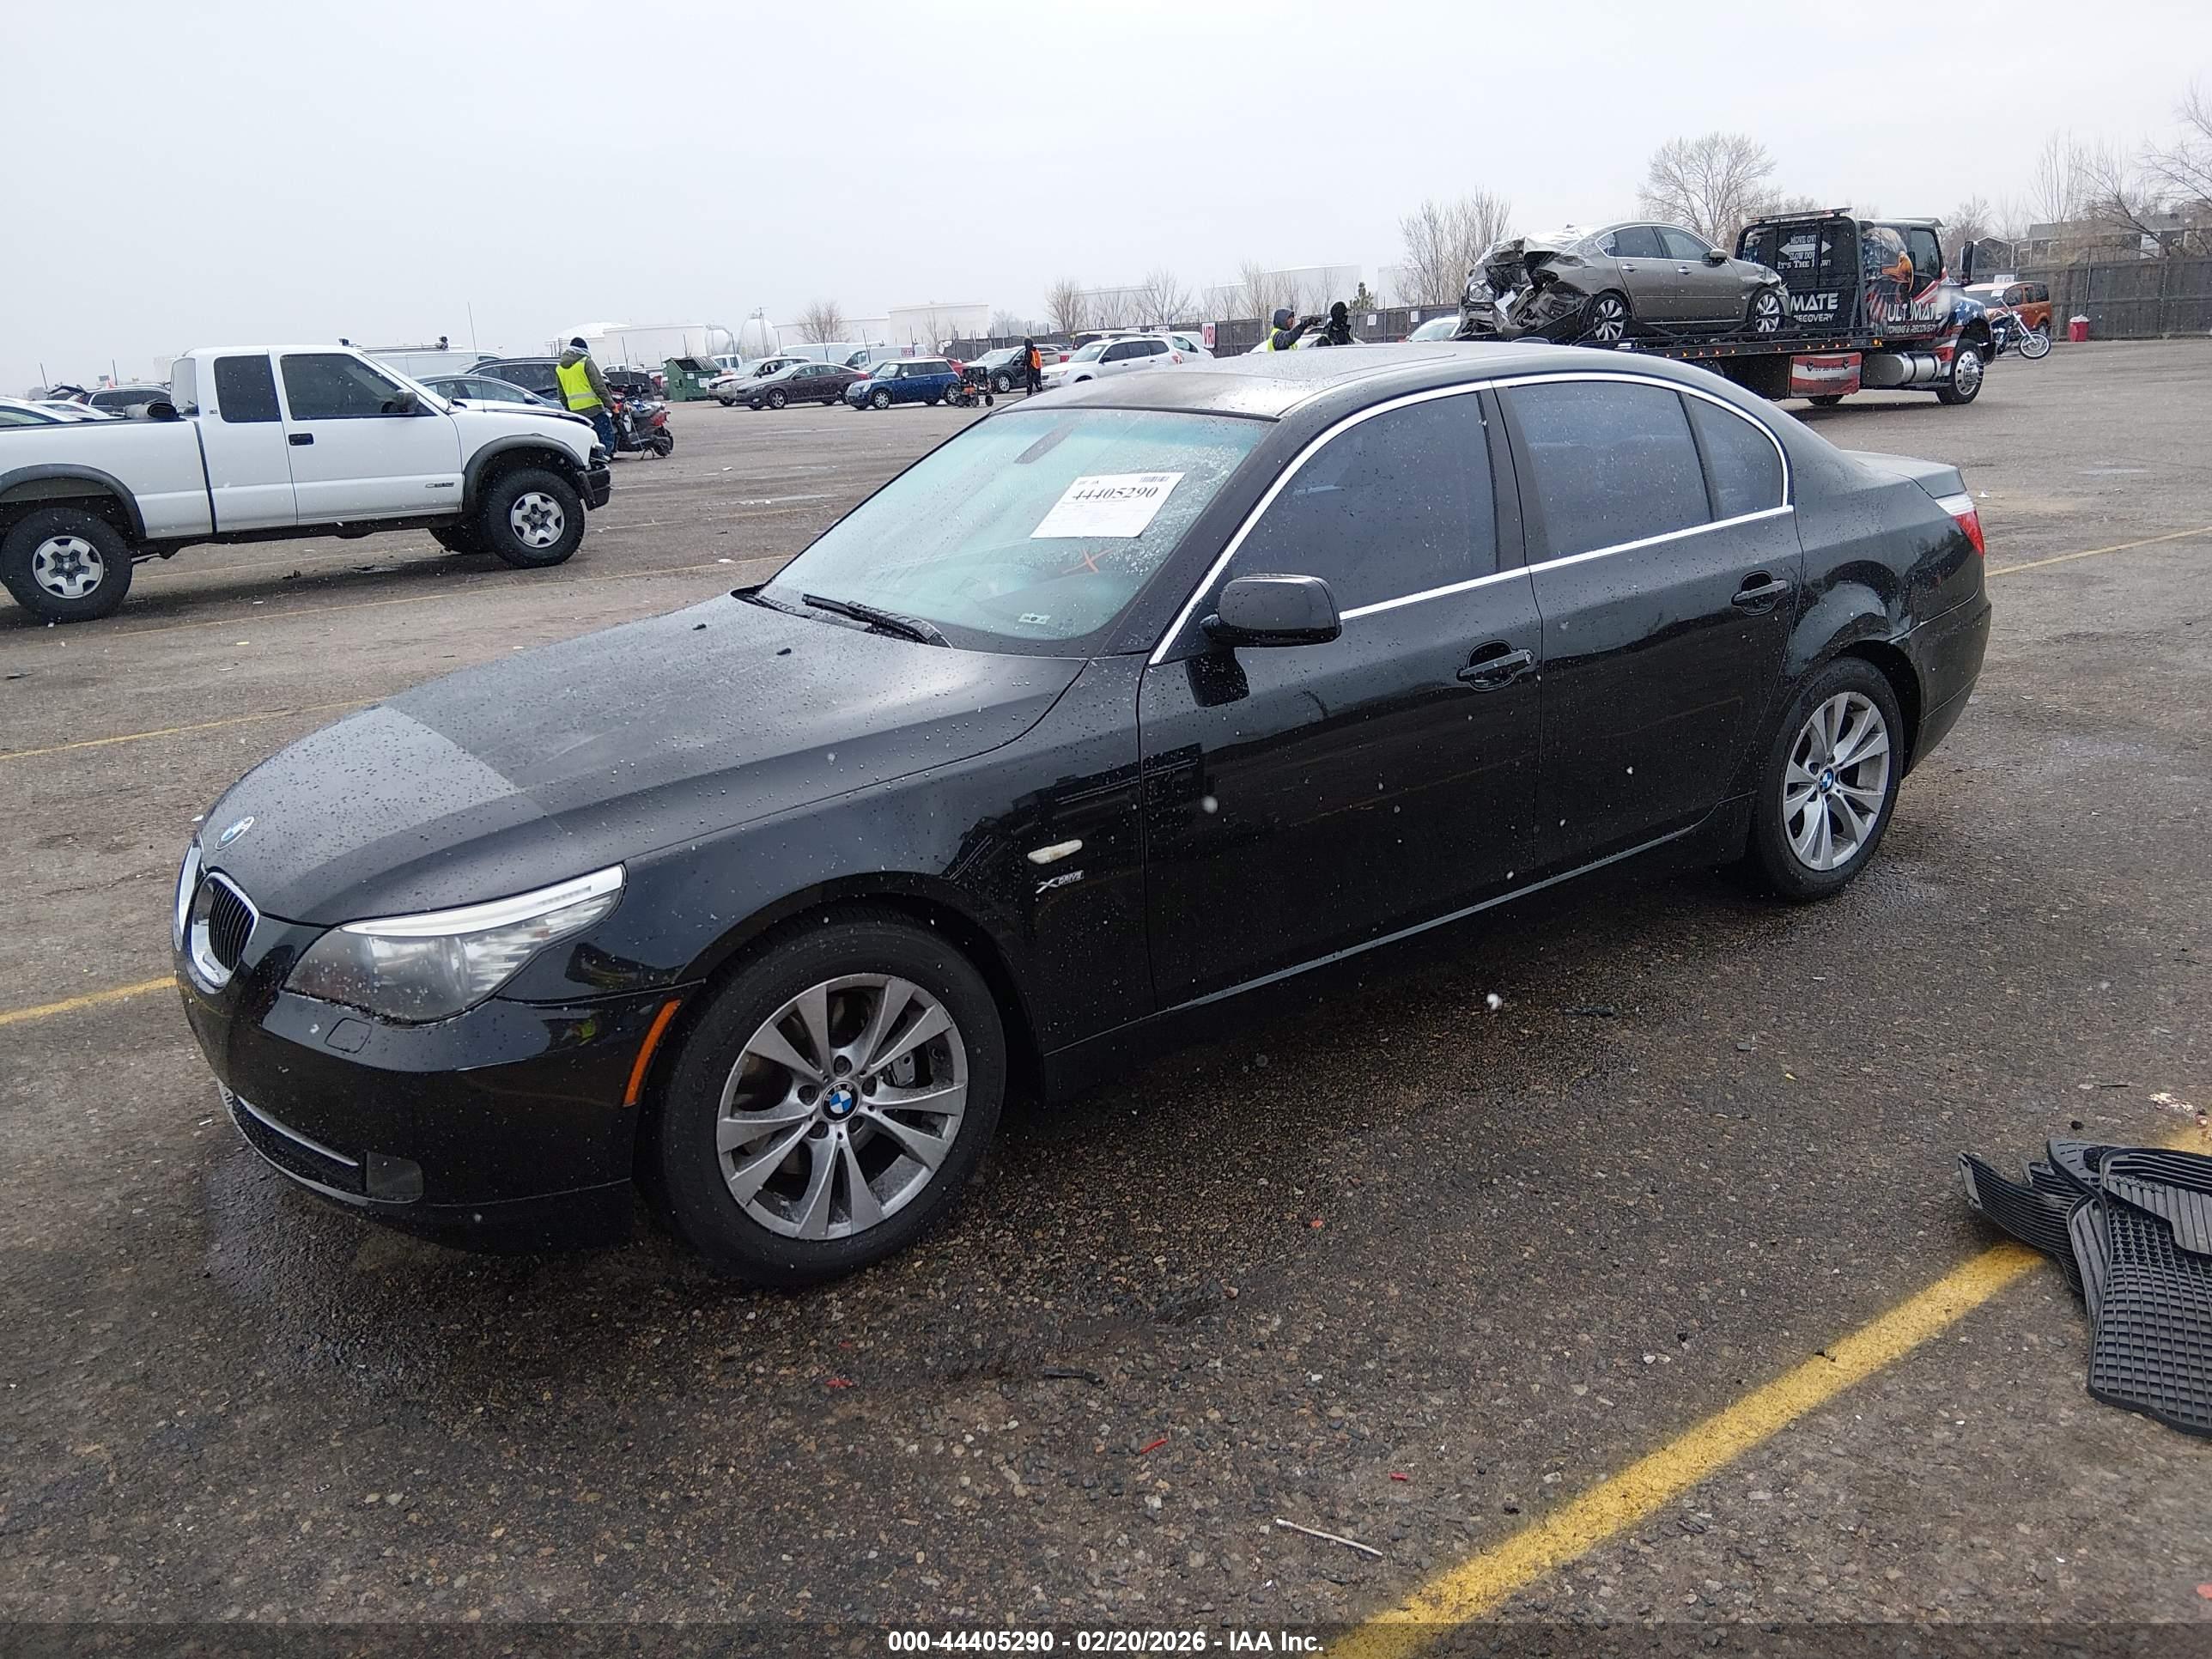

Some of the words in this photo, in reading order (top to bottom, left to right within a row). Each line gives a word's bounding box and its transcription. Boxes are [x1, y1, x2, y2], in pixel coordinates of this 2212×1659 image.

[1790, 235, 1807, 245] MOVE
[1807, 234, 1817, 243] OV
[1789, 252, 1804, 260] SLOW
[1794, 260, 1810, 269] THE
[1072, 486, 1159, 501] 44405290
